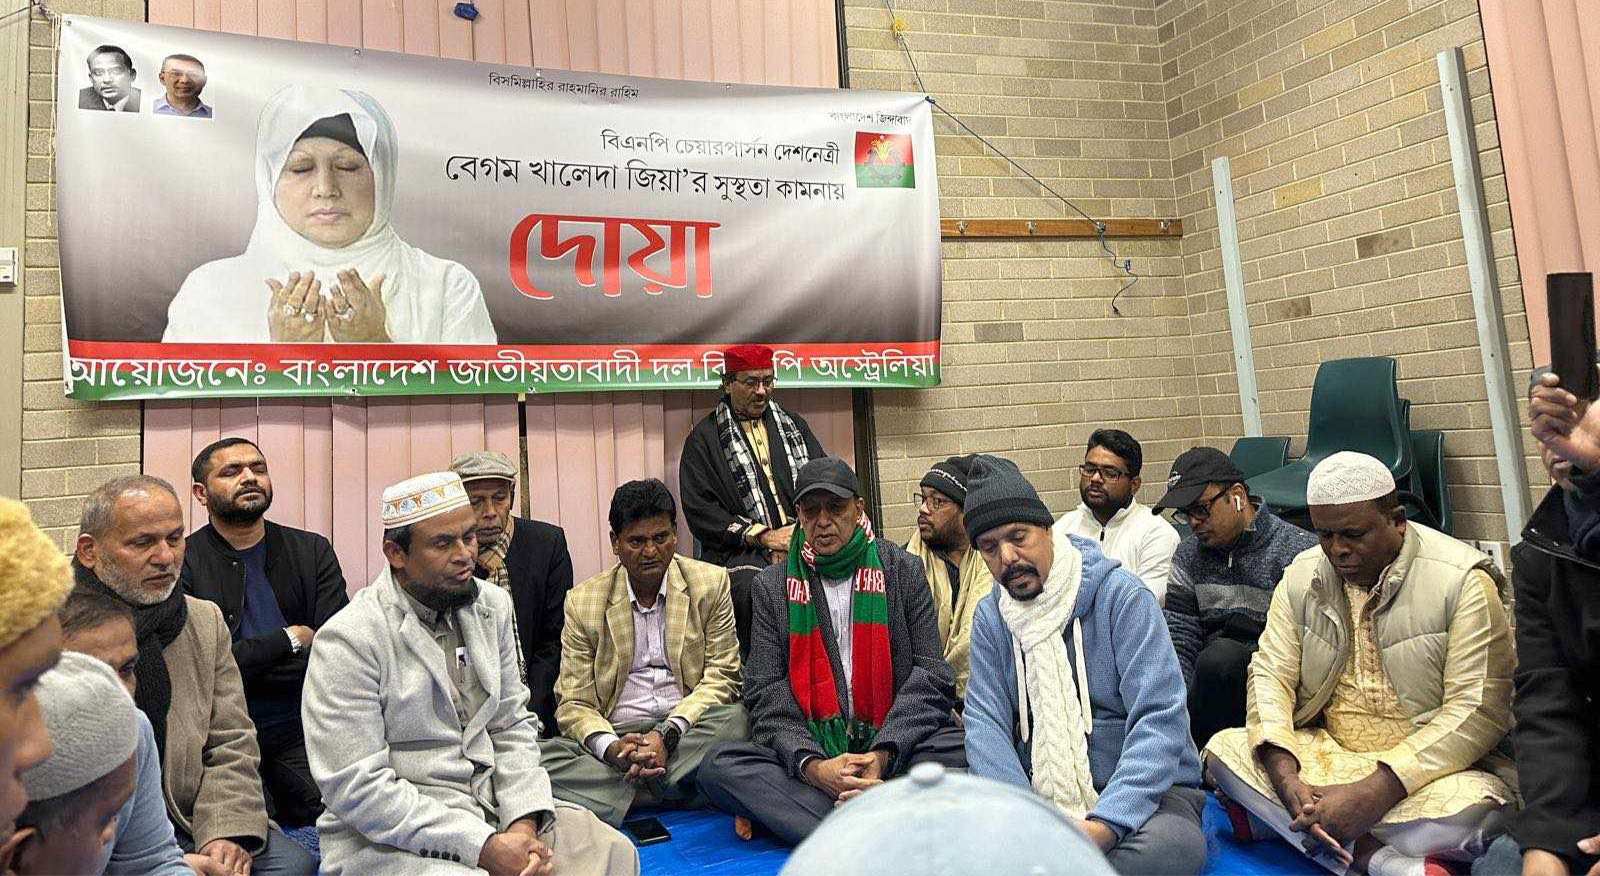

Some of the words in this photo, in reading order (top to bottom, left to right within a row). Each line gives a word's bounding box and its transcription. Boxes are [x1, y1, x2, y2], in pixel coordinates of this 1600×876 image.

[557, 82, 607, 97] রাহমানির
[609, 84, 640, 98] রাহিম
[600, 128, 669, 154] বিএনপি
[675, 137, 768, 157] চেয়ারপার্সন
[774, 141, 841, 165] দেশনেত্রী
[446, 155, 521, 184] বেগম
[529, 159, 619, 190] খালেদা
[713, 175, 770, 202] সুস্থতা
[775, 179, 847, 201] কামনায়
[508, 212, 721, 300] দোয়া
[280, 358, 439, 387] বাংলাদেশ
[447, 349, 642, 387] জাতীয়তাবাদী
[809, 348, 936, 382] অস্ট্রেলিয়া
